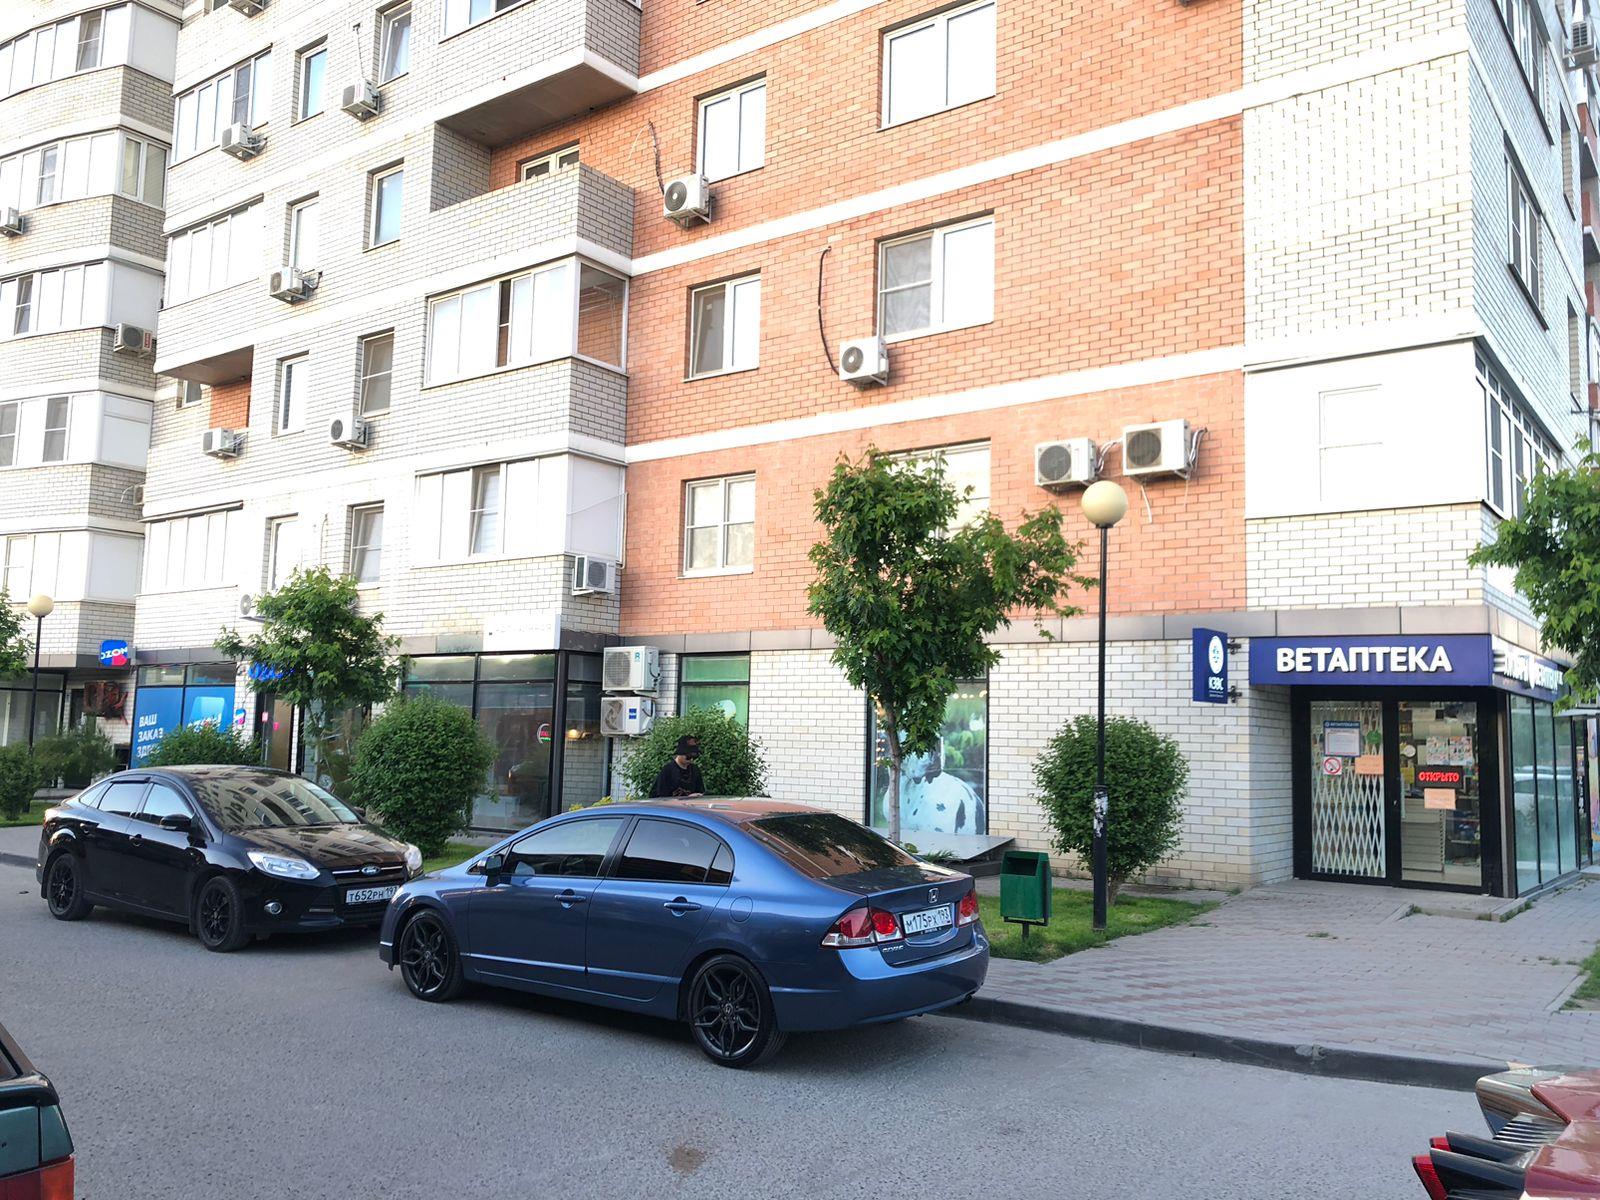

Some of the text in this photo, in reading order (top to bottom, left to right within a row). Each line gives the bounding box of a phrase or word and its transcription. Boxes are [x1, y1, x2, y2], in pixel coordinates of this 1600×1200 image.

[101, 647, 128, 660] OZON
[1276, 646, 1453, 672] ВЕТАПТЕКА
[139, 713, 158, 728] ВАШ
[137, 727, 164, 743] ЗАКАЗ
[136, 744, 161, 759] ЗДЕ
[1418, 771, 1460, 782] ОТКРЫТО
